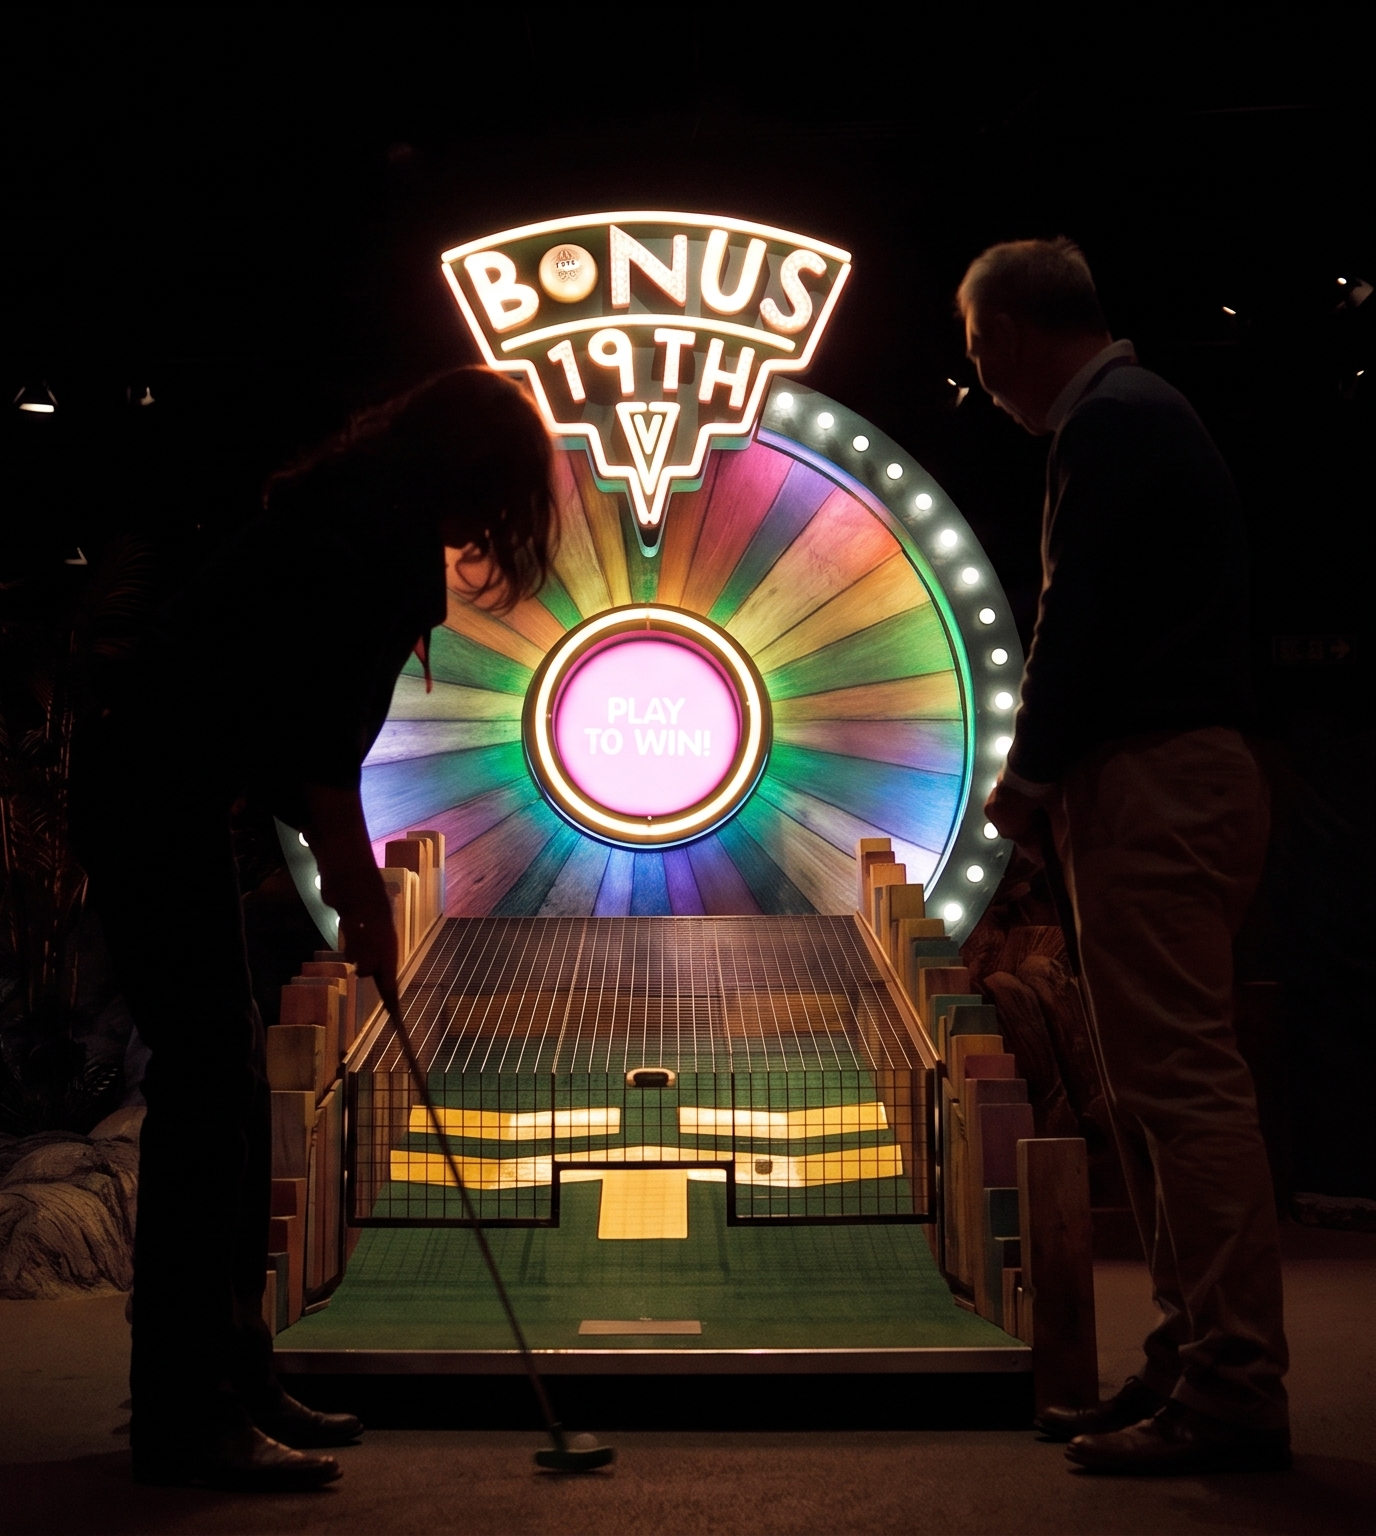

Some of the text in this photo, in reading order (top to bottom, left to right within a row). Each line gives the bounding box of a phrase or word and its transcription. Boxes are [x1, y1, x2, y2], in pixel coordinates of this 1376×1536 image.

[464, 224, 827, 334] BONUS
[547, 327, 756, 410] 19TH
[607, 696, 686, 725] PLAY
[583, 727, 711, 757] TO WIN!
